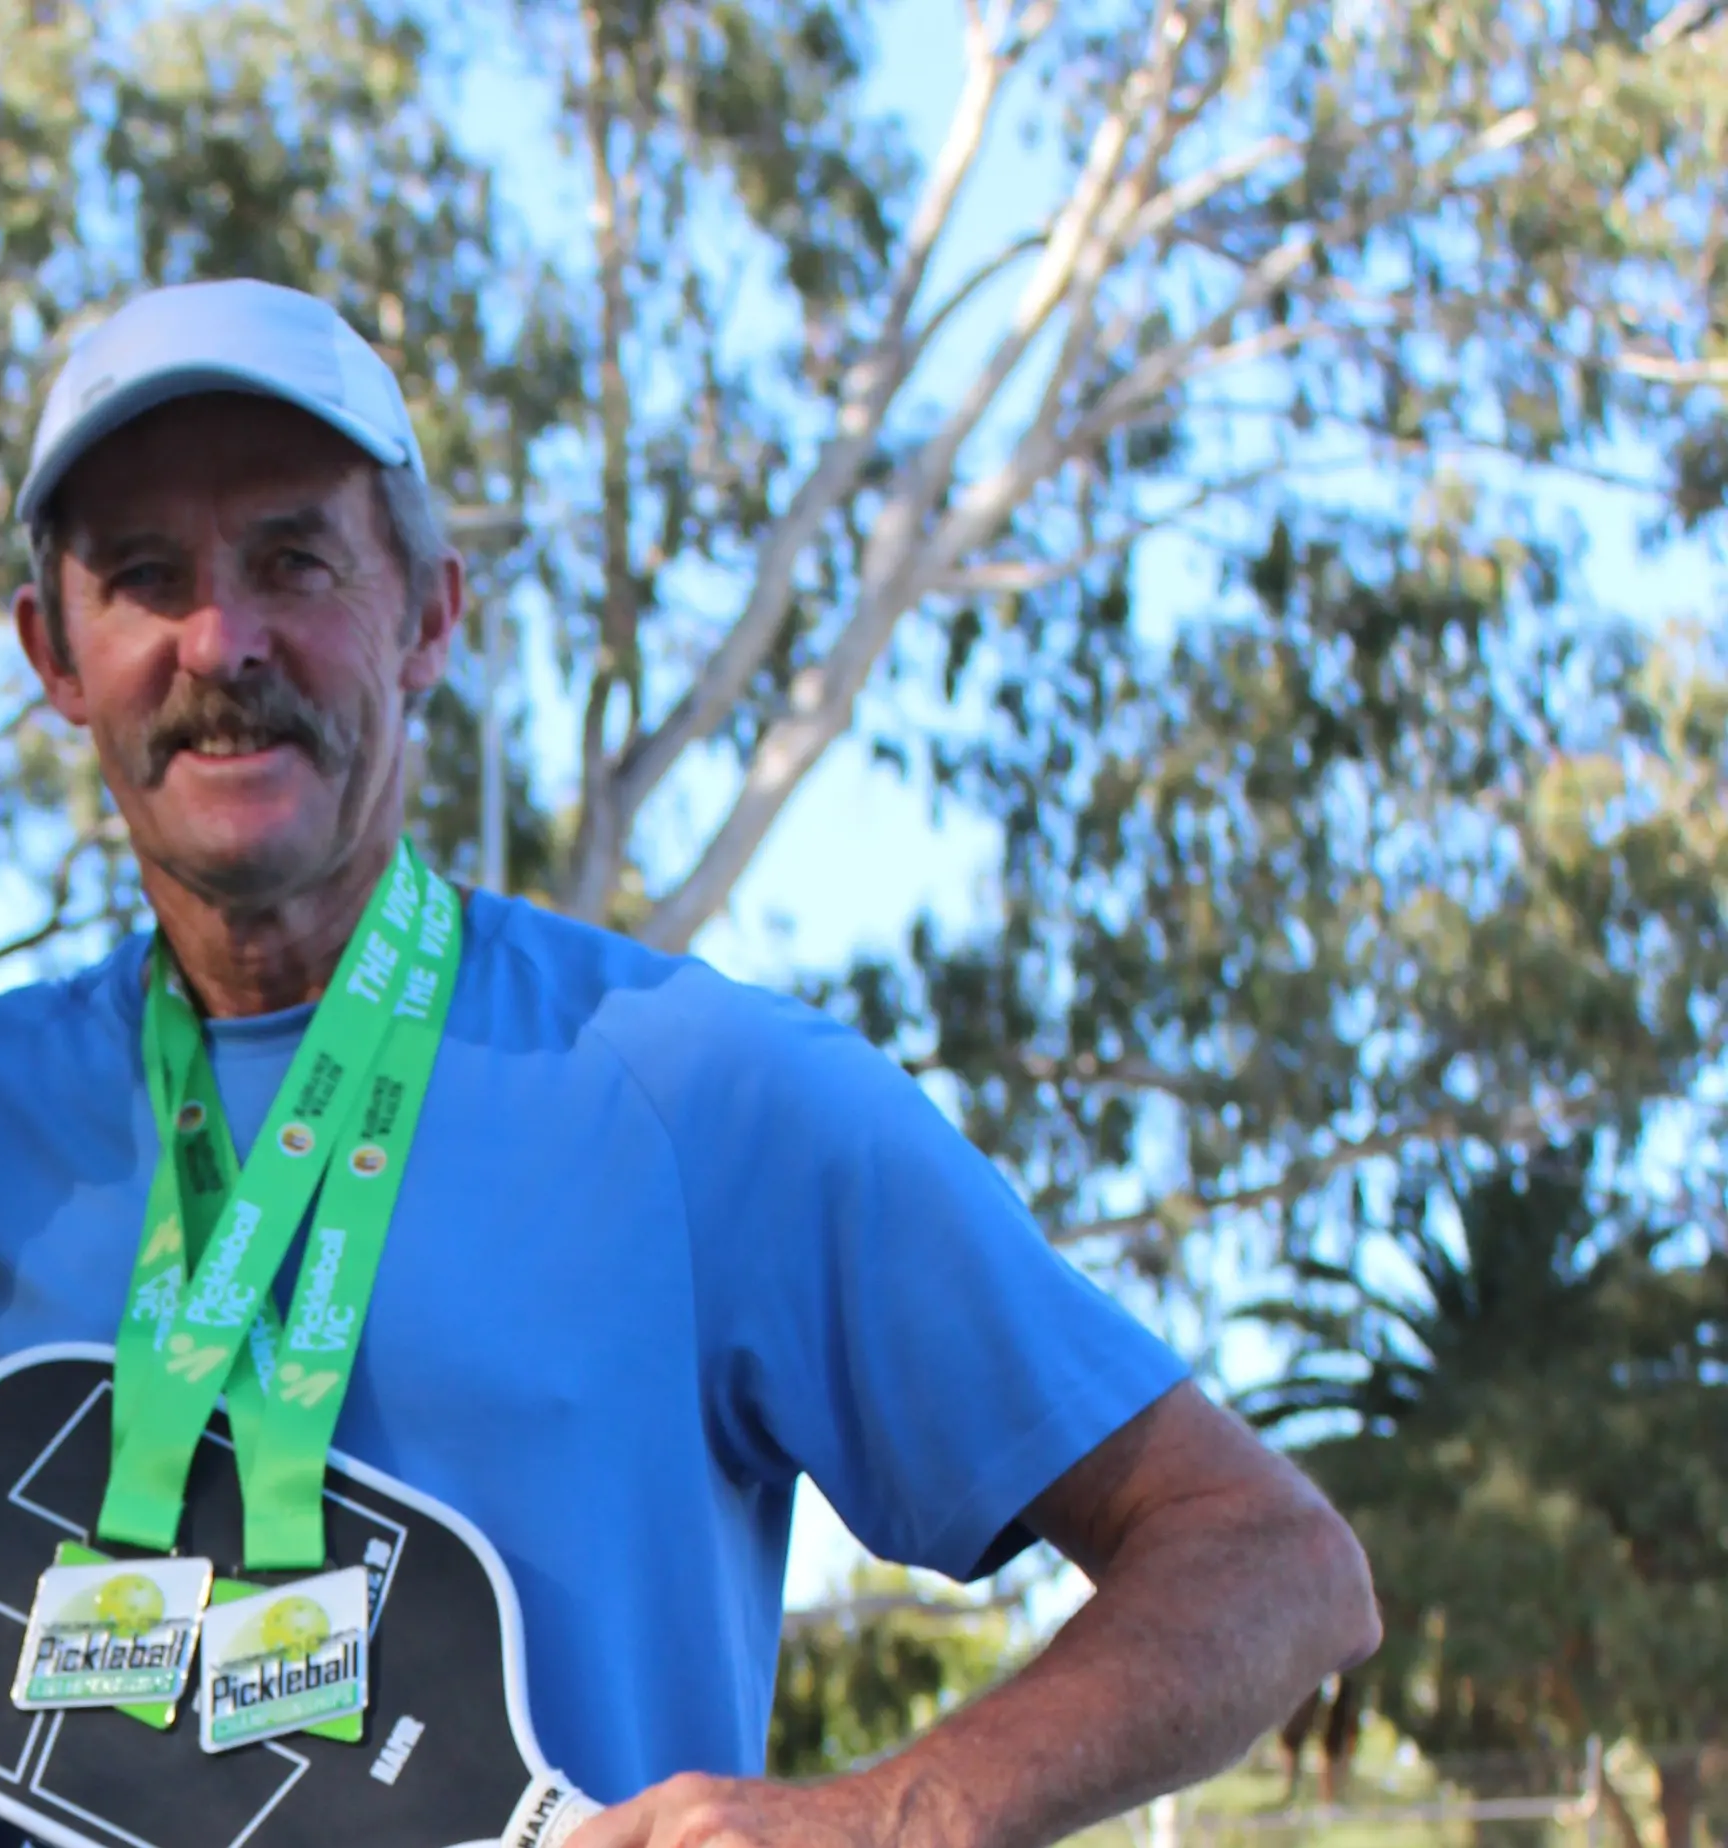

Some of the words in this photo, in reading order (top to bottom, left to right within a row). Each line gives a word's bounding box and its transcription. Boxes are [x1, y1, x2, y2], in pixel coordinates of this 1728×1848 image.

[347, 931, 398, 1004] THE
[393, 964, 440, 1021] THE
[185, 1198, 262, 1325] Pickleball
[289, 1227, 347, 1351] Pickleball
[212, 1282, 257, 1326] VIC
[317, 1304, 356, 1351] VIC
[31, 1628, 189, 1675] Pickleball
[211, 1640, 358, 1717] Pickleball
[516, 1786, 565, 1848] HAMR
